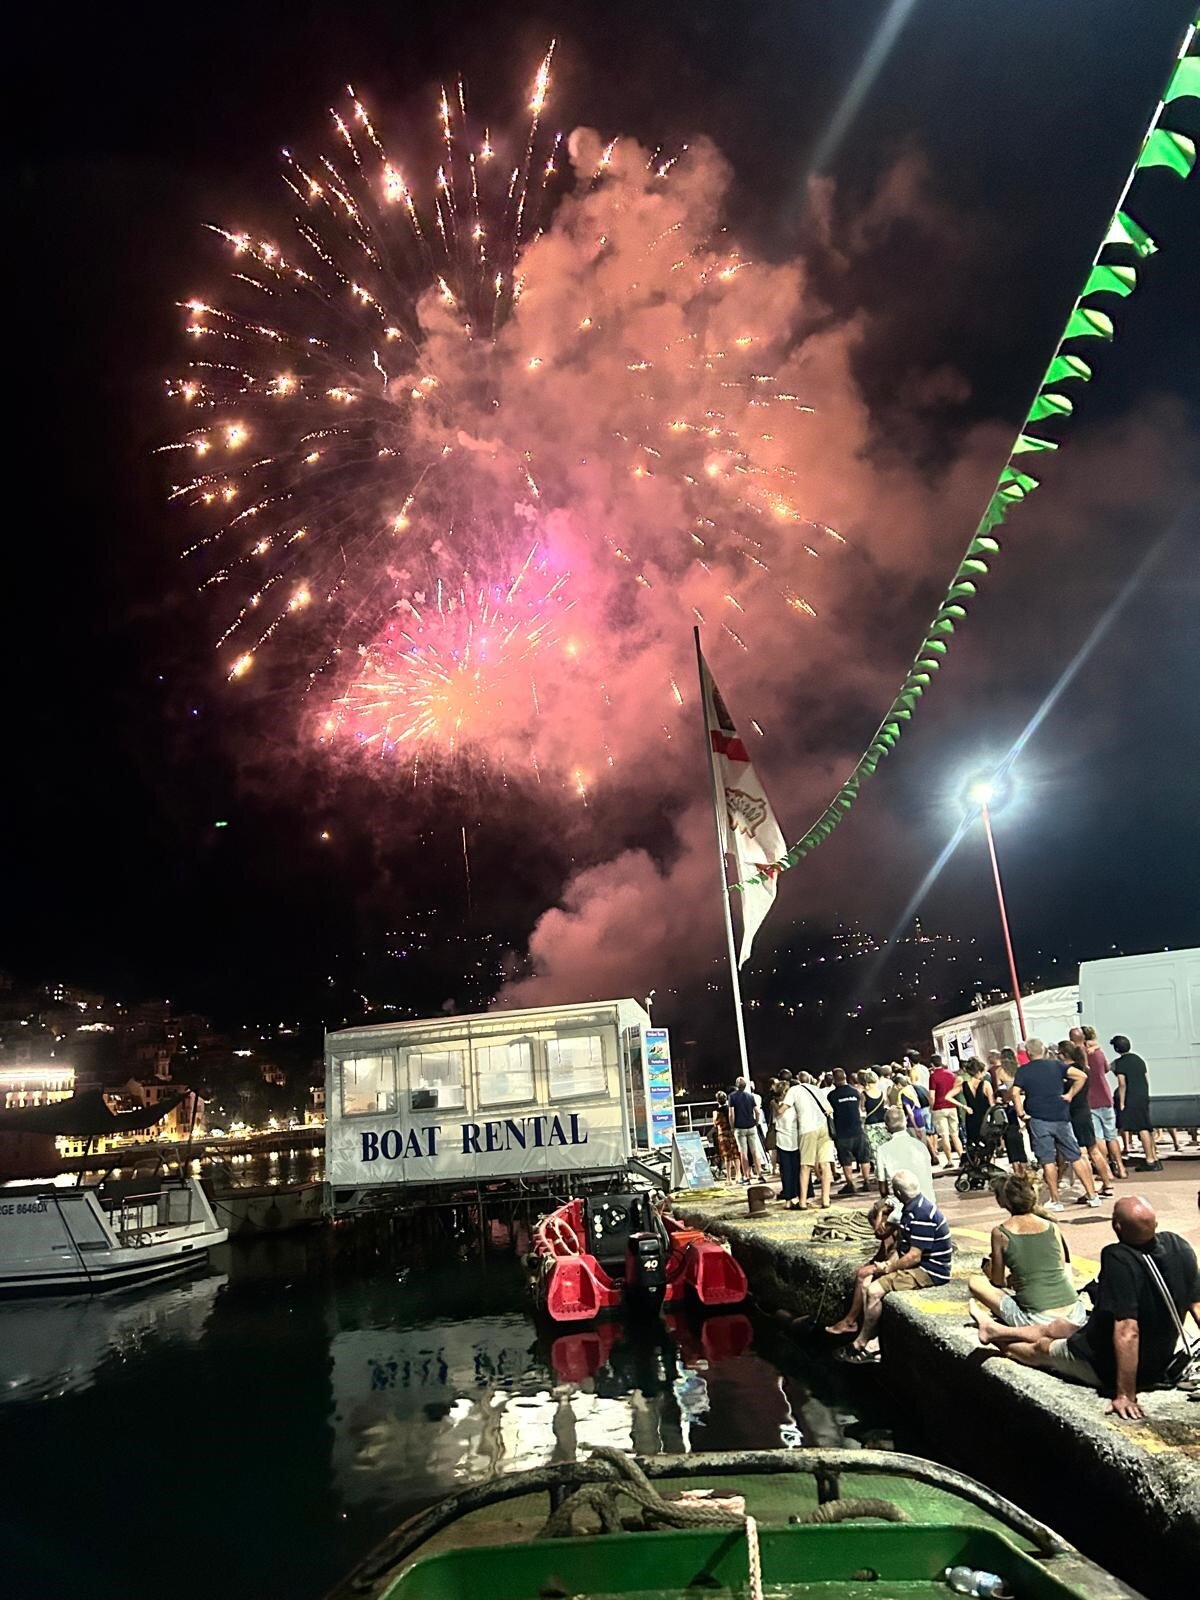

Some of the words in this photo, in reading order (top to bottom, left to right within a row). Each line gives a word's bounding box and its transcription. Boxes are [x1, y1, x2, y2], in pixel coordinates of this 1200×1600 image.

[360, 1126, 441, 1162] BOAT
[461, 1113, 588, 1154] RENTAL
[0, 1204, 14, 1215] GE
[644, 1260, 658, 1268] 40
